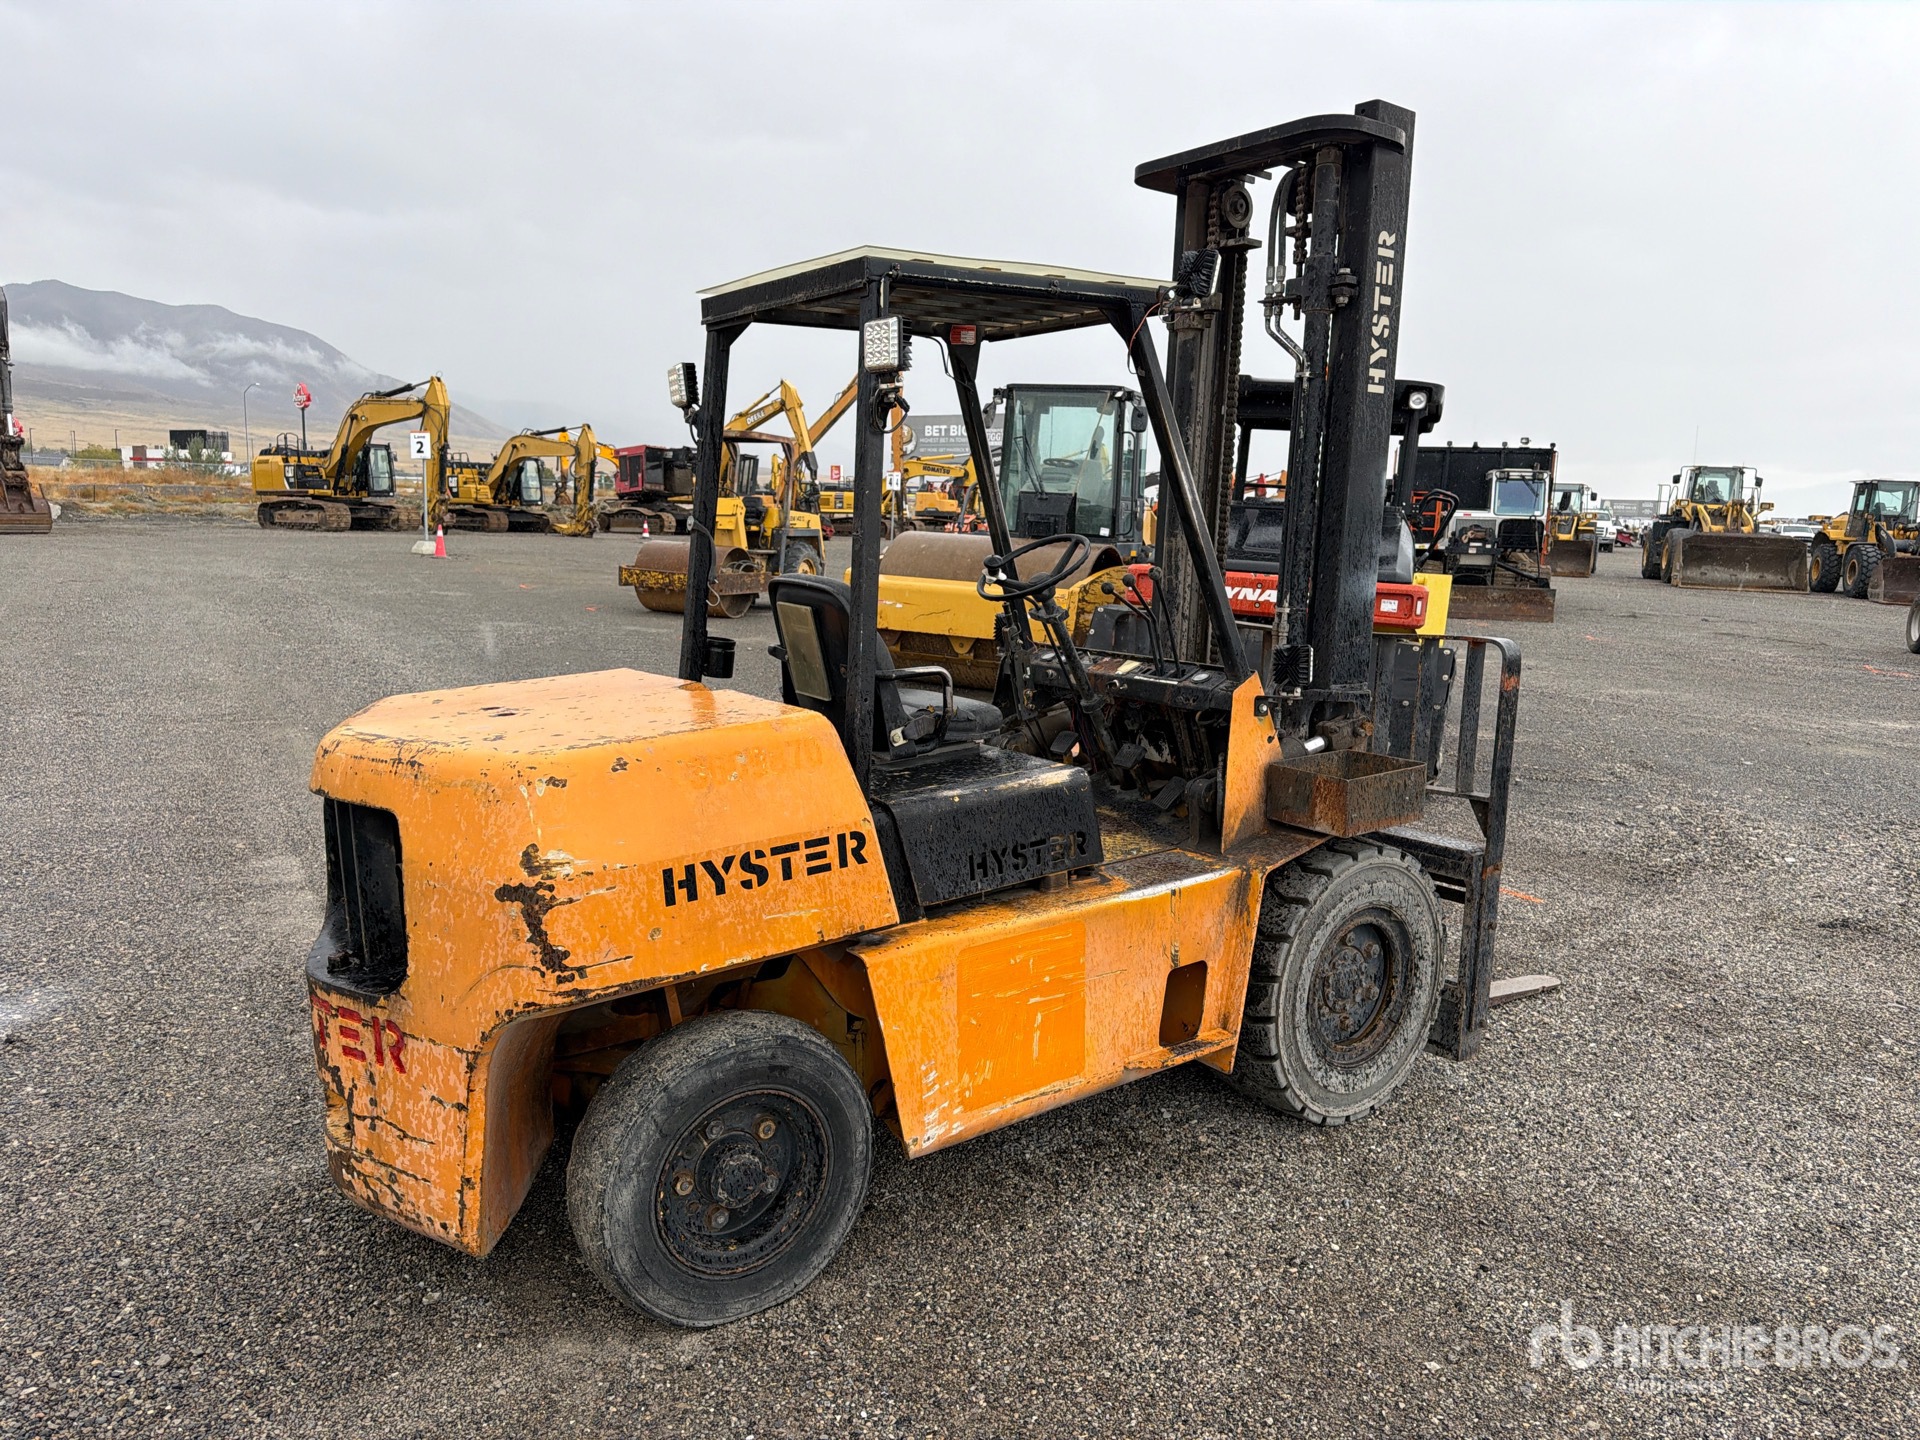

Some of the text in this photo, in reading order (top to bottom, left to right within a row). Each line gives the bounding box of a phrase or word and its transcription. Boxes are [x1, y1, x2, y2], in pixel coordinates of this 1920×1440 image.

[1367, 230, 1396, 394] HYSTER
[746, 409, 765, 425] DEERE
[925, 425, 947, 436] BET
[415, 440, 425, 454] 2
[922, 464, 950, 475] KOMATSU
[968, 831, 1088, 881] HYSTER
[662, 830, 868, 907] HYSTER
